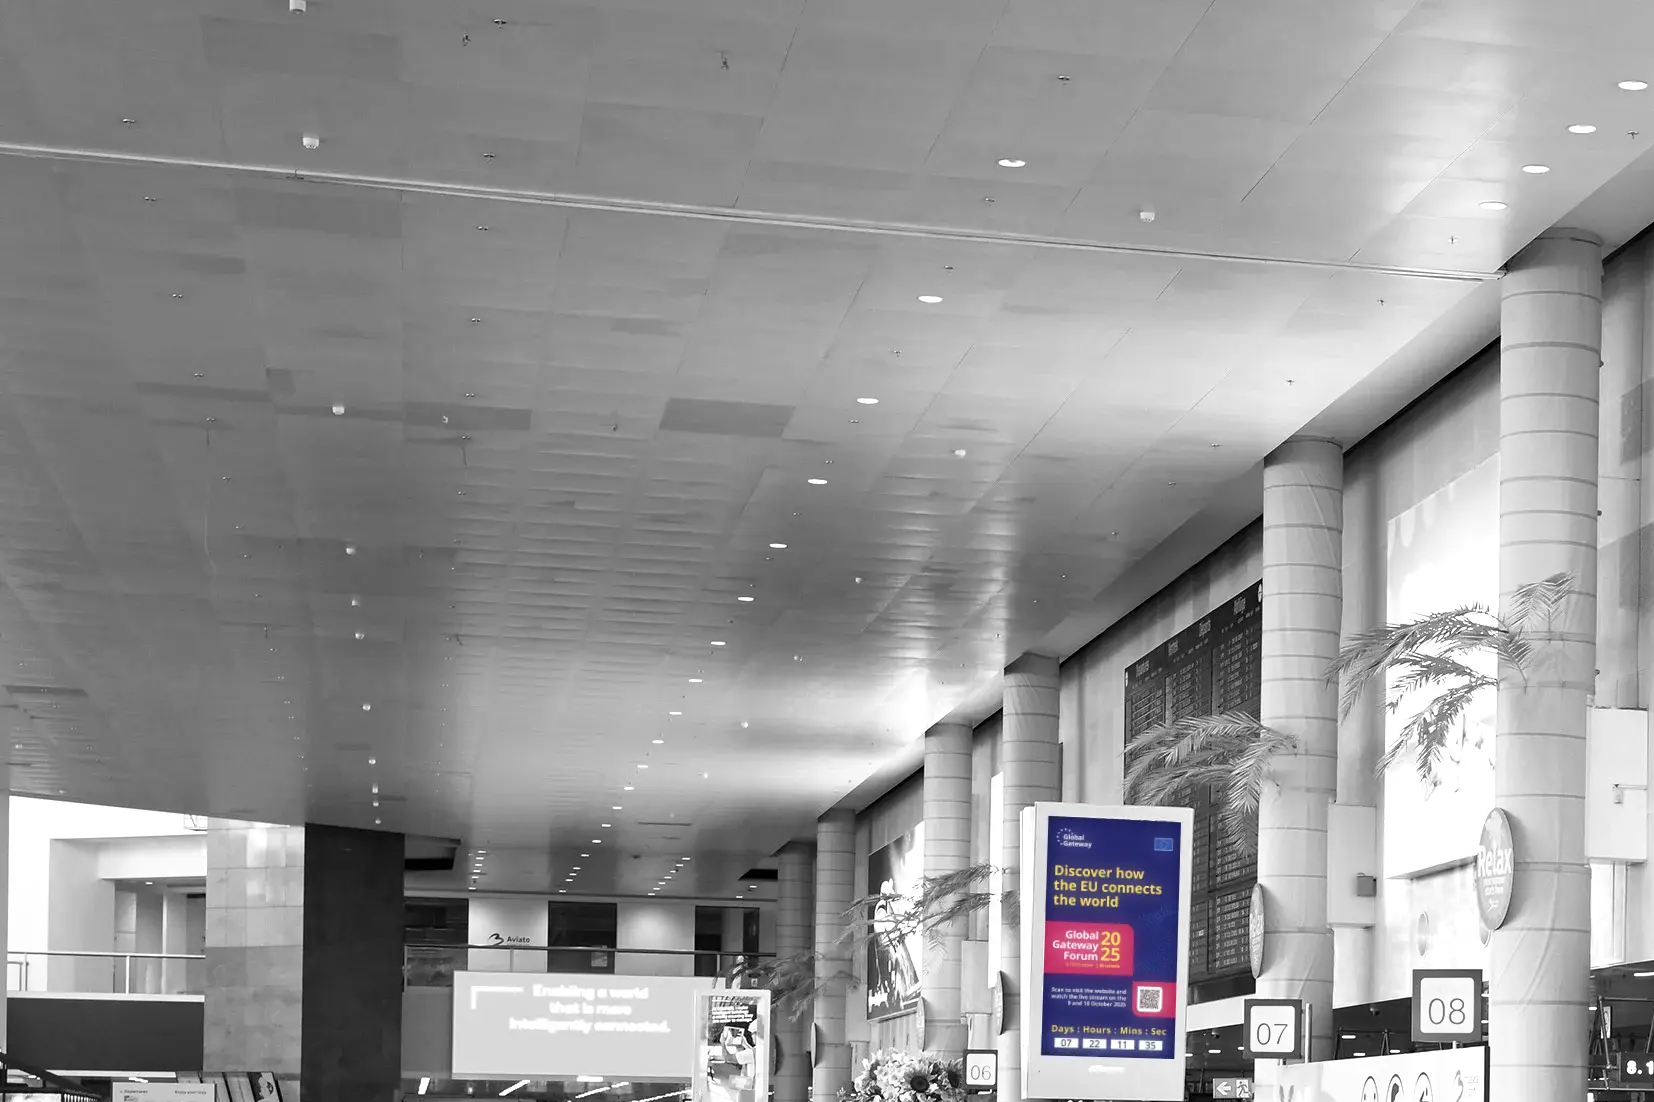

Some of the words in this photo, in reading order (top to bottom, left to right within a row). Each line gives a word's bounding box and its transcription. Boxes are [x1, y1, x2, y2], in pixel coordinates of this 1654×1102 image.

[1478, 845, 1512, 877] Relax
[1055, 865, 1112, 878] Discover
[1116, 867, 1144, 879] how
[1054, 880, 1076, 891] the
[1081, 881, 1098, 892] EU
[1102, 884, 1162, 894] connects
[1054, 894, 1076, 906] the
[1080, 896, 1118, 907] world
[1065, 931, 1098, 940] Global
[1101, 932, 1120, 946] 20
[1053, 940, 1098, 952] Gateway
[1064, 952, 1098, 960] Forum
[1101, 948, 1120, 961] 25
[1429, 998, 1466, 1025] 08
[1052, 1025, 1074, 1034] Days
[1083, 1026, 1111, 1034] Hours
[1120, 1027, 1142, 1035] Mins
[1257, 1023, 1288, 1045] 07
[1061, 1039, 1071, 1047] 07
[1089, 1040, 1100, 1048] 22
[970, 1064, 991, 1081] 06
[1627, 1060, 1654, 1075] 8.1
